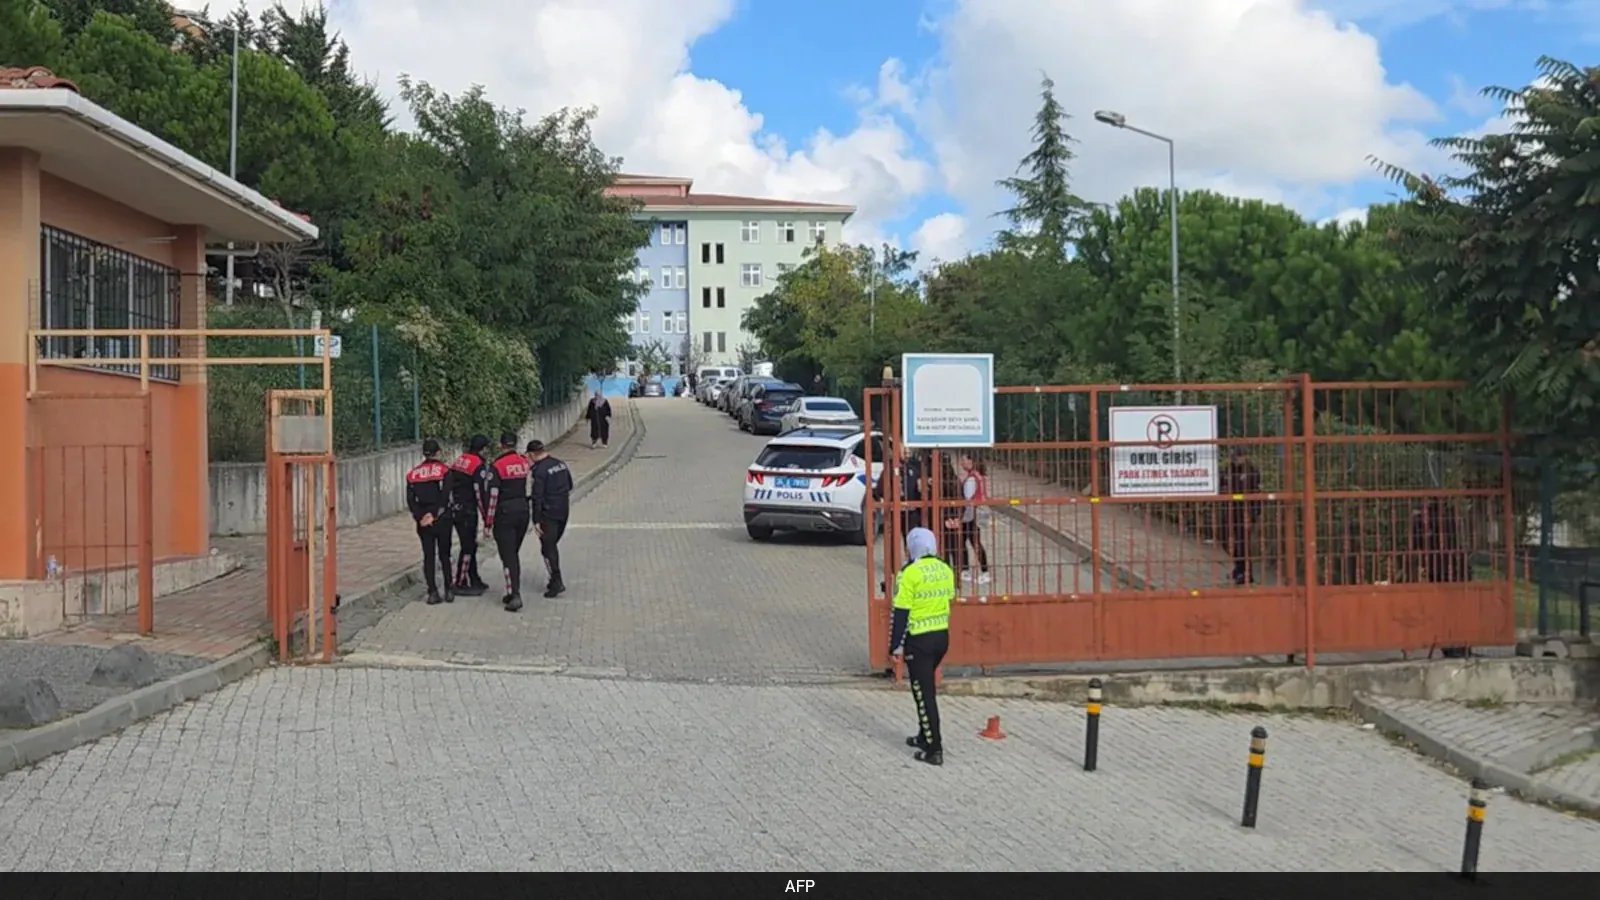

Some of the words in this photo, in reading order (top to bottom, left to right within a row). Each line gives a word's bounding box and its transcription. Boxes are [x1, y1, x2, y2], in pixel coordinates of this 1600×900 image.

[1130, 452, 1159, 465] OKUL
[1162, 449, 1197, 467] GİRİŞİ
[1118, 469, 1139, 479] PARK
[1142, 469, 1168, 478] ETMEK
